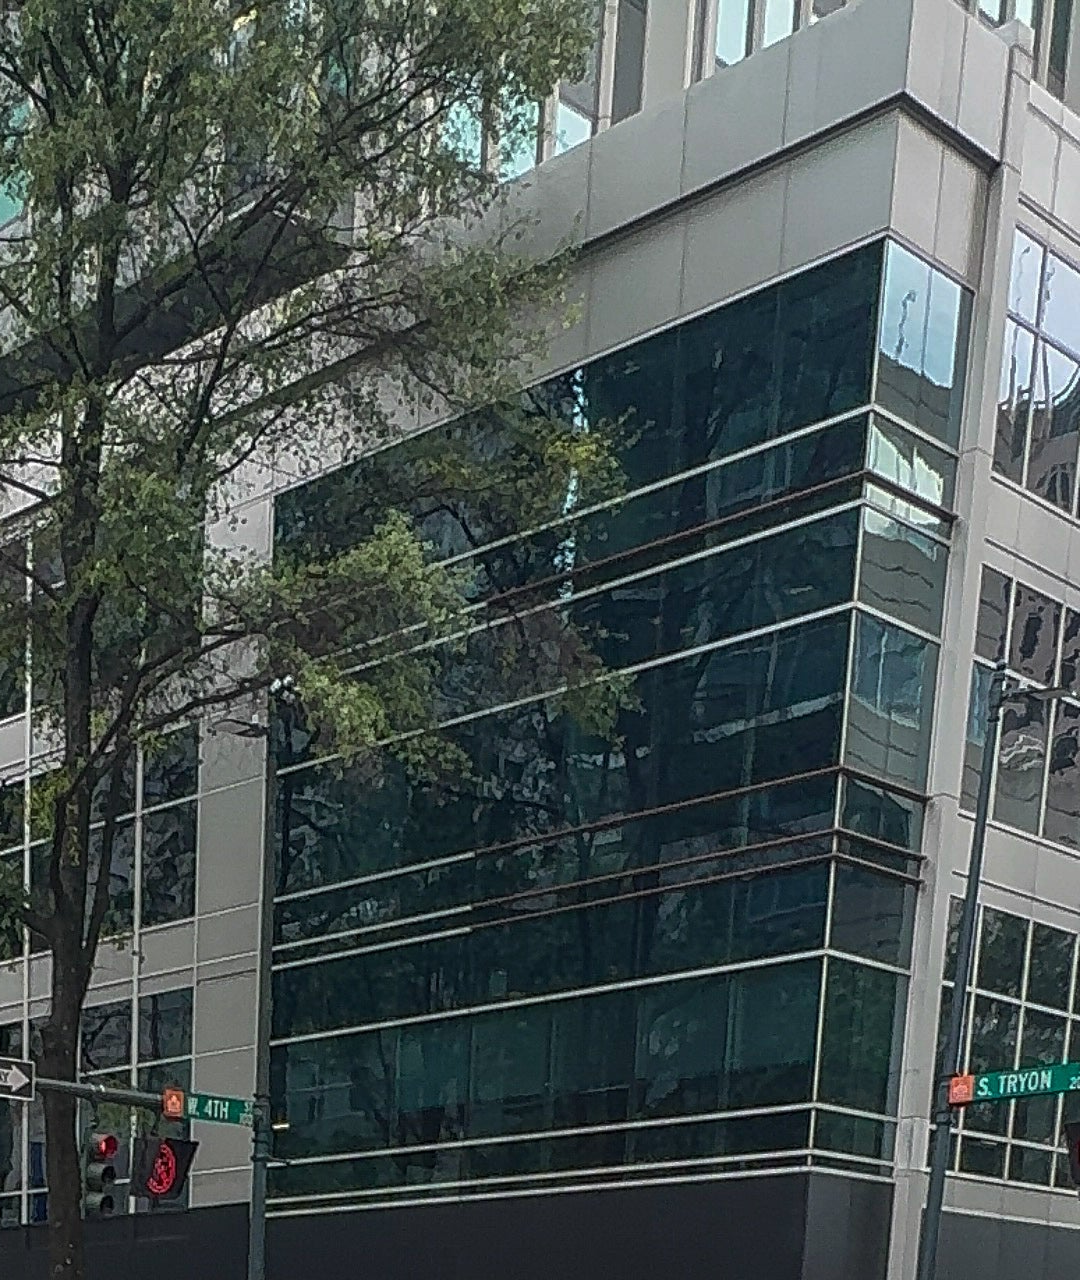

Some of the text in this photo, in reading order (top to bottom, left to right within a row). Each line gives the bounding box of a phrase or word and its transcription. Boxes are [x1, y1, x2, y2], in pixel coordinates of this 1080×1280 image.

[977, 1069, 1053, 1096] S. TRYON
[203, 1099, 229, 1119] 4TH
